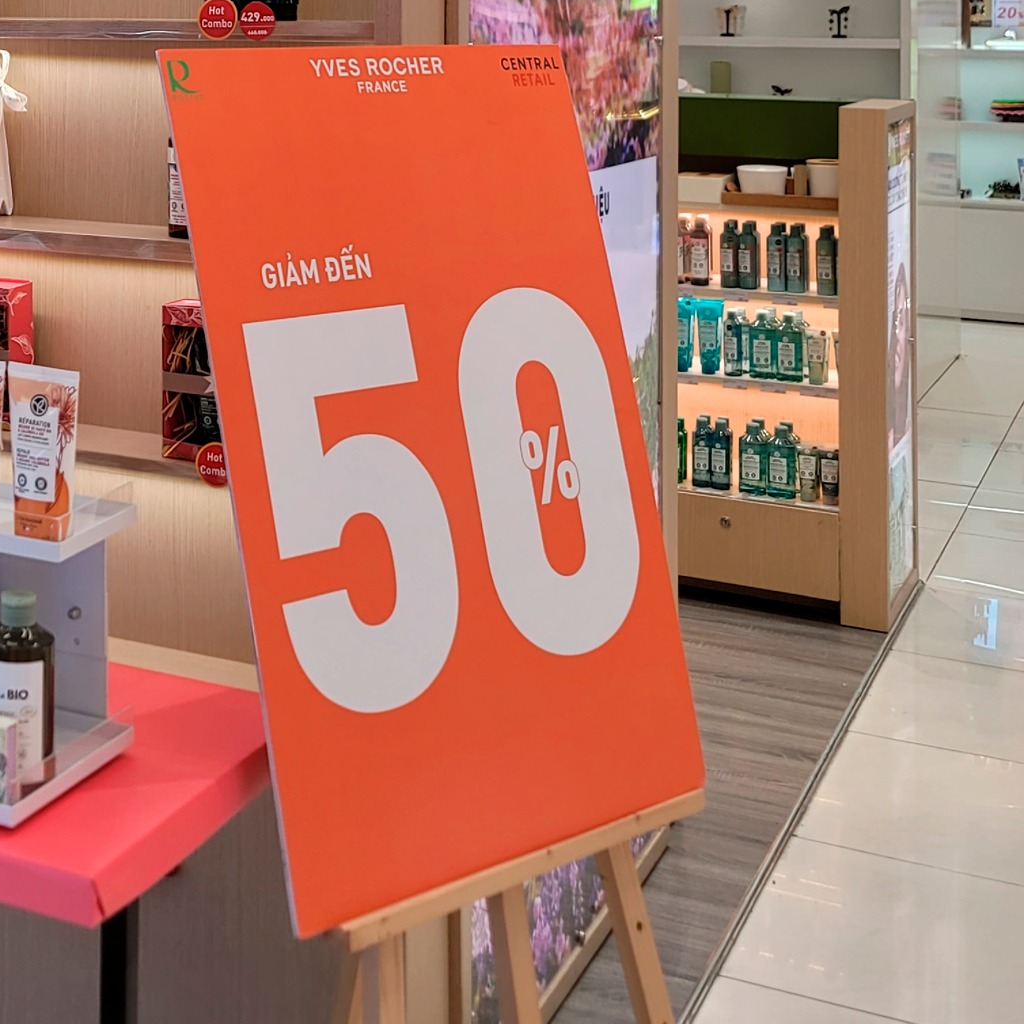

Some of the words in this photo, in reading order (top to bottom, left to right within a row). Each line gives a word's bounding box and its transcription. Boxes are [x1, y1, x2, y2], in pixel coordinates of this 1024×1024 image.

[209, 6, 224, 16] Hot
[202, 19, 233, 28] Combo
[309, 58, 360, 77] YVES
[366, 56, 444, 76] ROCHER
[501, 57, 559, 71] CENTRAL
[357, 80, 408, 94] FRANCE
[512, 73, 556, 87] RETAIL
[261, 251, 319, 289] GIẢM
[324, 244, 373, 282] ĐẾN
[207, 451, 223, 463] Hot
[7, 689, 29, 700] BIO
